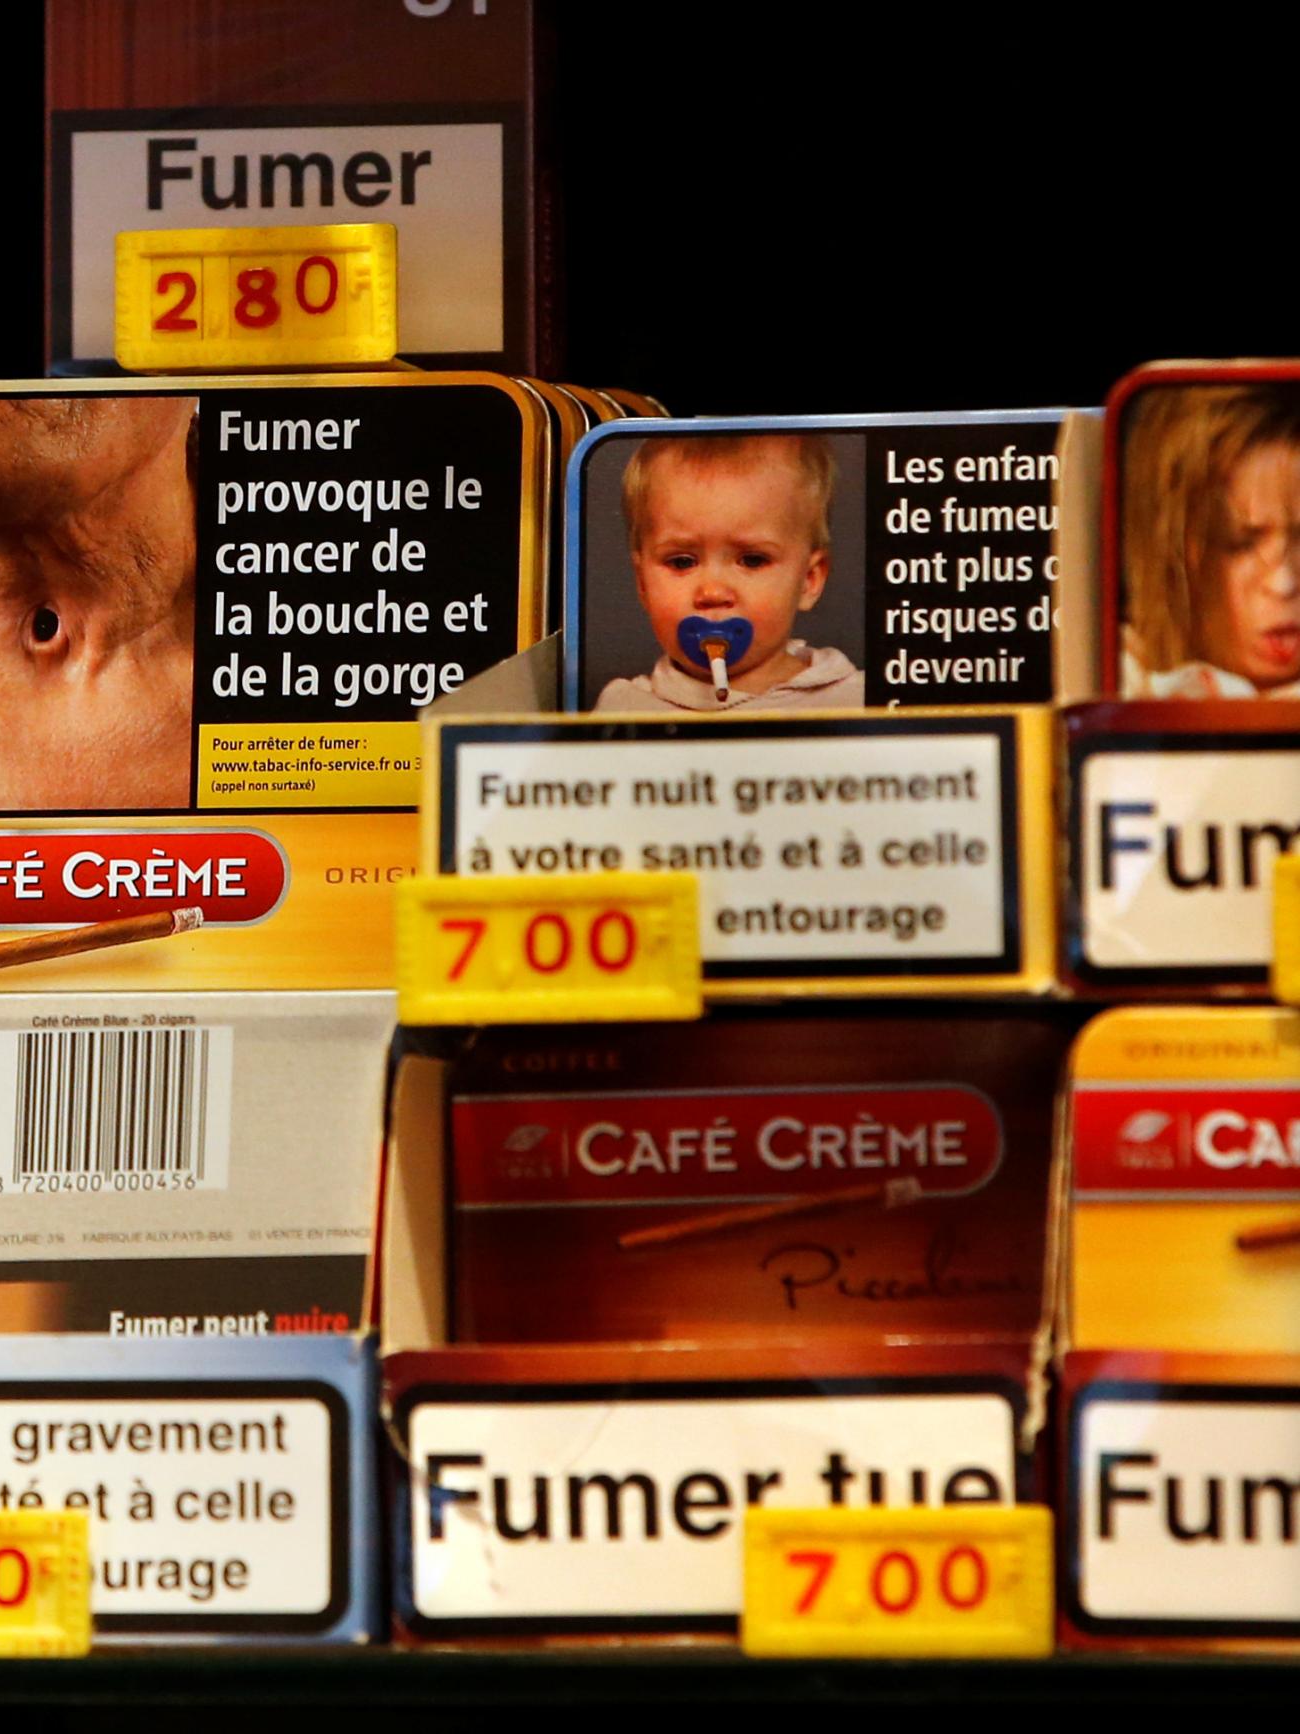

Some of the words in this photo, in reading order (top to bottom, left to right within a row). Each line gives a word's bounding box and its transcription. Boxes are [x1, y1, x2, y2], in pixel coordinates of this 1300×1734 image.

[147, 138, 431, 211] Fumer
[219, 411, 360, 451] Fumer
[887, 450, 944, 484] Les
[955, 445, 1059, 483] enfan
[218, 479, 429, 525] provoque
[445, 466, 482, 509] le
[886, 499, 930, 534] de
[941, 497, 1058, 533] fumeu
[216, 540, 359, 574] cancer
[372, 528, 426, 572] de
[885, 552, 947, 584] ont
[957, 547, 1033, 591] plus
[215, 591, 252, 635] la
[268, 589, 429, 635] bouche
[444, 593, 488, 632] et
[885, 600, 1016, 642] risques
[212, 652, 266, 697] de
[282, 652, 319, 696] la
[334, 661, 464, 707] gorge
[885, 649, 1025, 685] devenir
[212, 738, 243, 751] Pour
[247, 737, 294, 750] arrêter
[298, 737, 315, 749] de
[319, 736, 360, 749] fumer
[212, 757, 389, 773] www.tabac-info-service.fr
[394, 760, 410, 770] ou
[211, 780, 245, 794] (appel
[248, 782, 269, 791] non
[271, 779, 315, 792] surtaxé)
[479, 774, 616, 809] Fumer
[633, 771, 718, 806] nuit
[734, 769, 978, 813] gravement
[469, 837, 492, 872] à
[509, 840, 622, 871] votre
[641, 836, 764, 870] santé
[781, 836, 821, 869] et
[838, 830, 863, 869] à
[881, 833, 989, 867] celle
[63, 849, 247, 898] CRÈME
[715, 899, 947, 941] entourage
[32, 1015, 58, 1027] Café
[63, 1015, 99, 1027] Crème
[103, 1015, 129, 1026] Blue
[142, 1015, 156, 1026] 20
[159, 1014, 196, 1027] cigars
[576, 1117, 737, 1177] CAFÉ
[759, 1114, 968, 1171] CRÈME
[22, 1174, 101, 1193] 720400
[114, 1173, 196, 1191] 000456
[110, 1310, 198, 1337] Fumer
[274, 1305, 348, 1335] nuire
[12, 1412, 287, 1463] gravement
[63, 1483, 110, 1521] et
[128, 1481, 155, 1522] à
[174, 1480, 295, 1522] celle
[425, 1452, 780, 1540] Fumer
